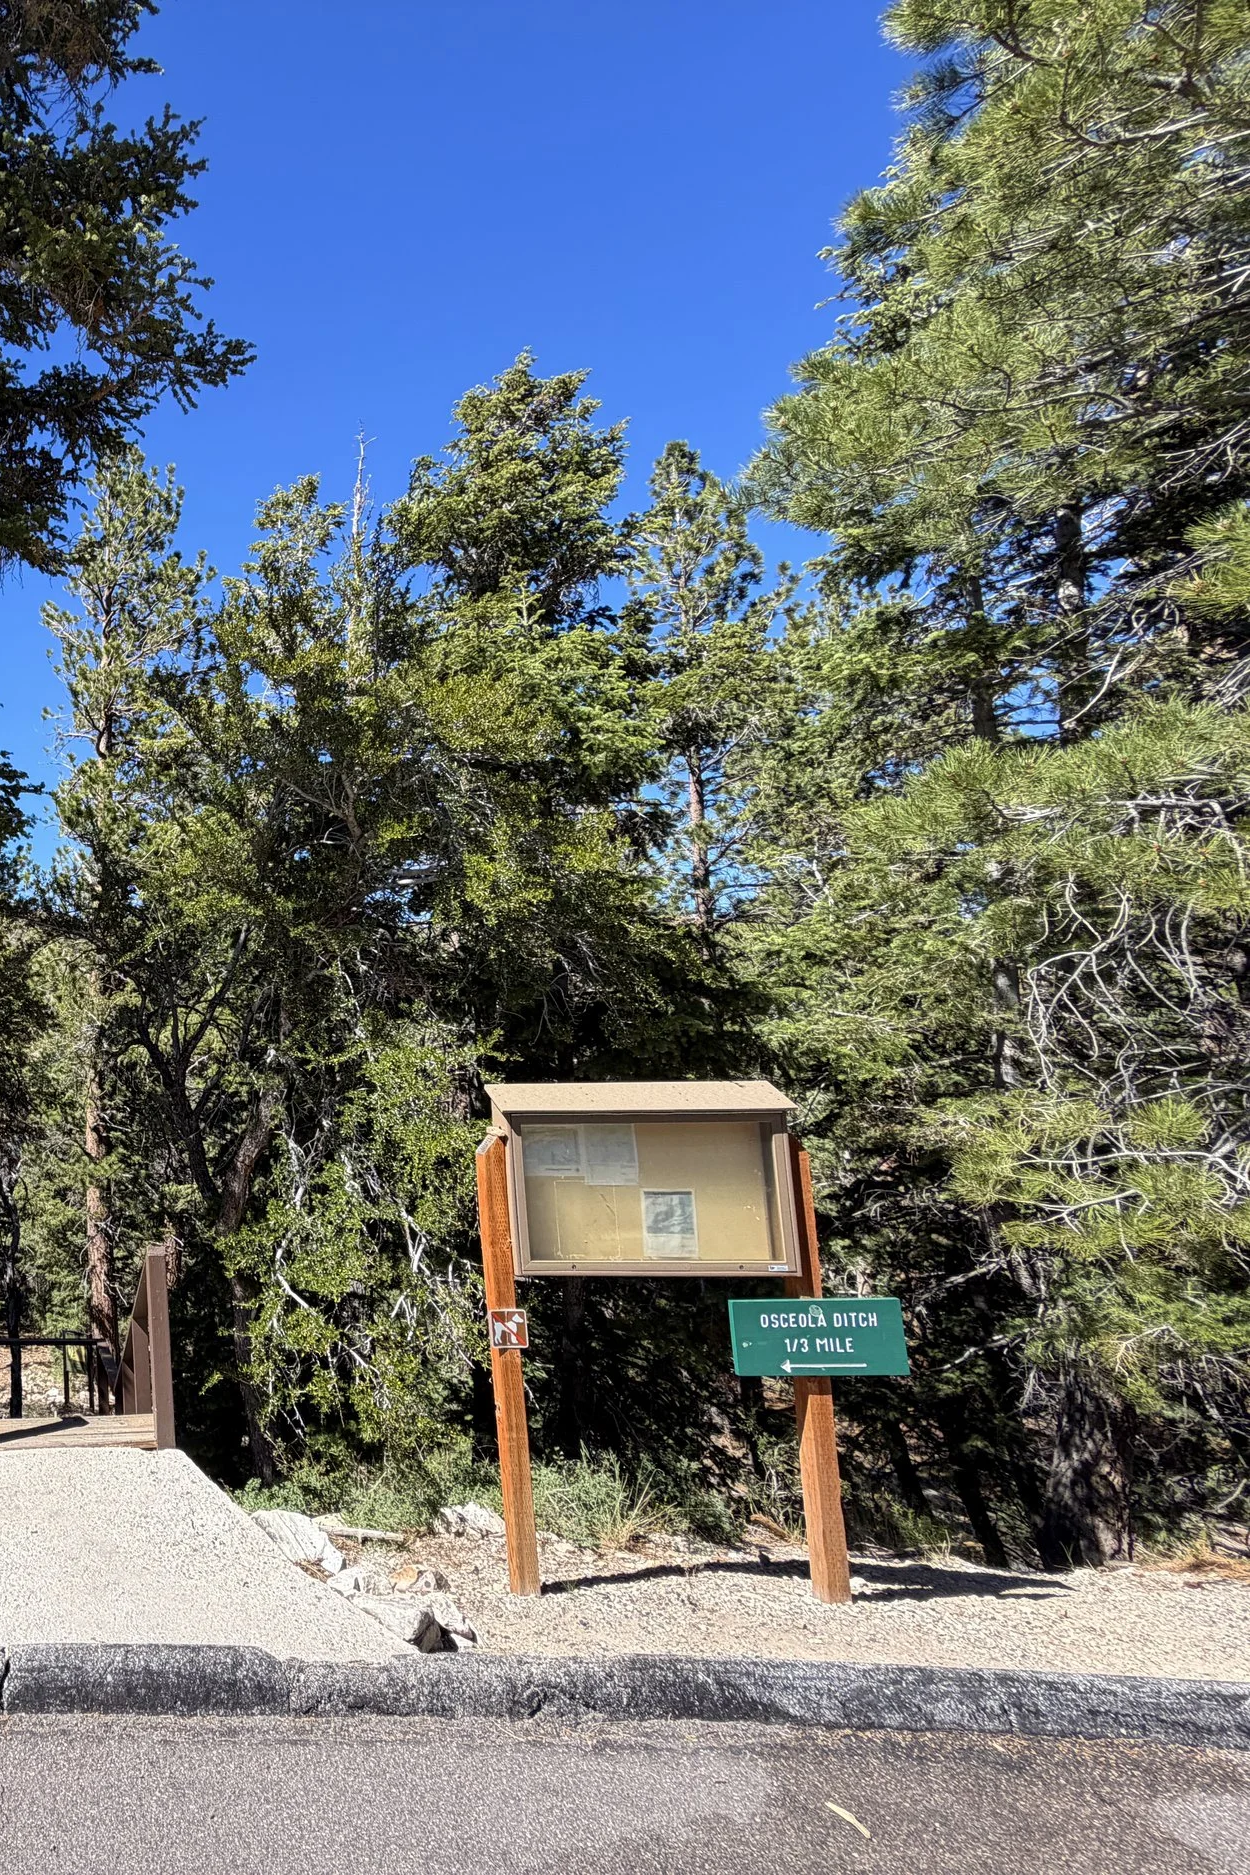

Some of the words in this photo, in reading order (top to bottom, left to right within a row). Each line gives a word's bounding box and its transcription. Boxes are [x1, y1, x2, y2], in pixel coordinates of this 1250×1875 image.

[760, 1313, 827, 1328] OSCEOLA
[833, 1312, 878, 1327] DITCH
[784, 1338, 809, 1353] 1/3
[816, 1338, 855, 1353] MILE
